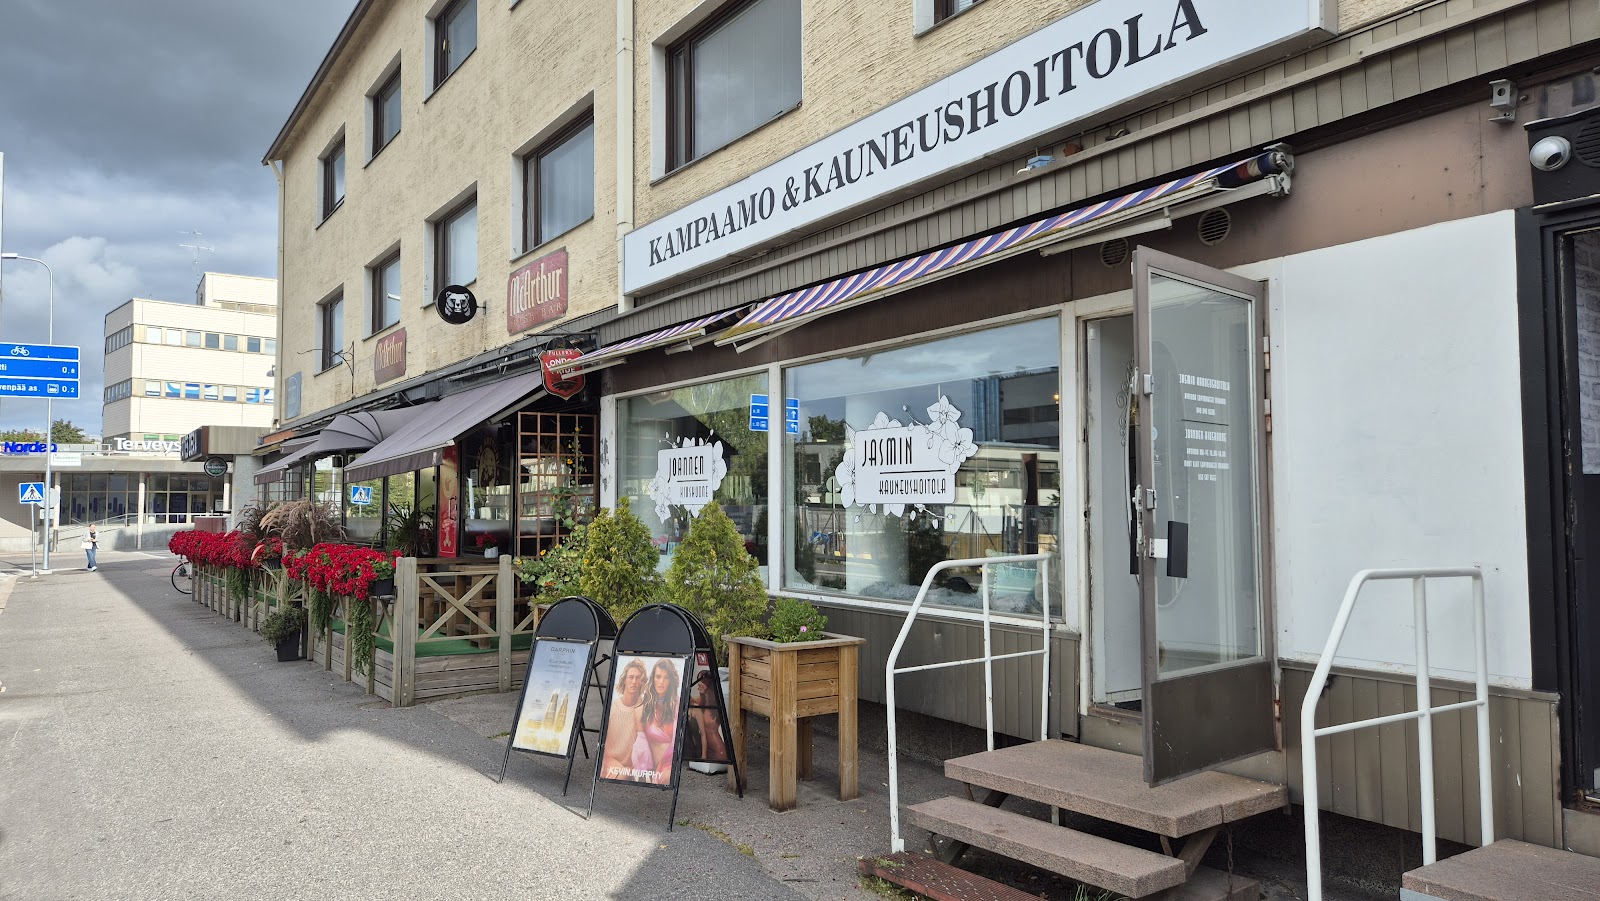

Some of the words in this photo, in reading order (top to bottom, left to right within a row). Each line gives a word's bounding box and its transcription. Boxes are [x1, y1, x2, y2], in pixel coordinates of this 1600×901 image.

[648, 186, 775, 267] KAMPAAMO
[782, 176, 801, 211] &
[803, 0, 1208, 203] KAUNEUSHOITOLA
[510, 262, 562, 317] McArthur
[541, 302, 562, 317] BAR
[62, 385, 75, 393] 0.2
[114, 437, 181, 454] Terveys
[862, 436, 913, 467] JASMIN
[667, 456, 704, 483] JOANNEN
[879, 478, 946, 495] KAUNEUSHOITOLA
[608, 766, 664, 780] KEVIN.MURPHY
